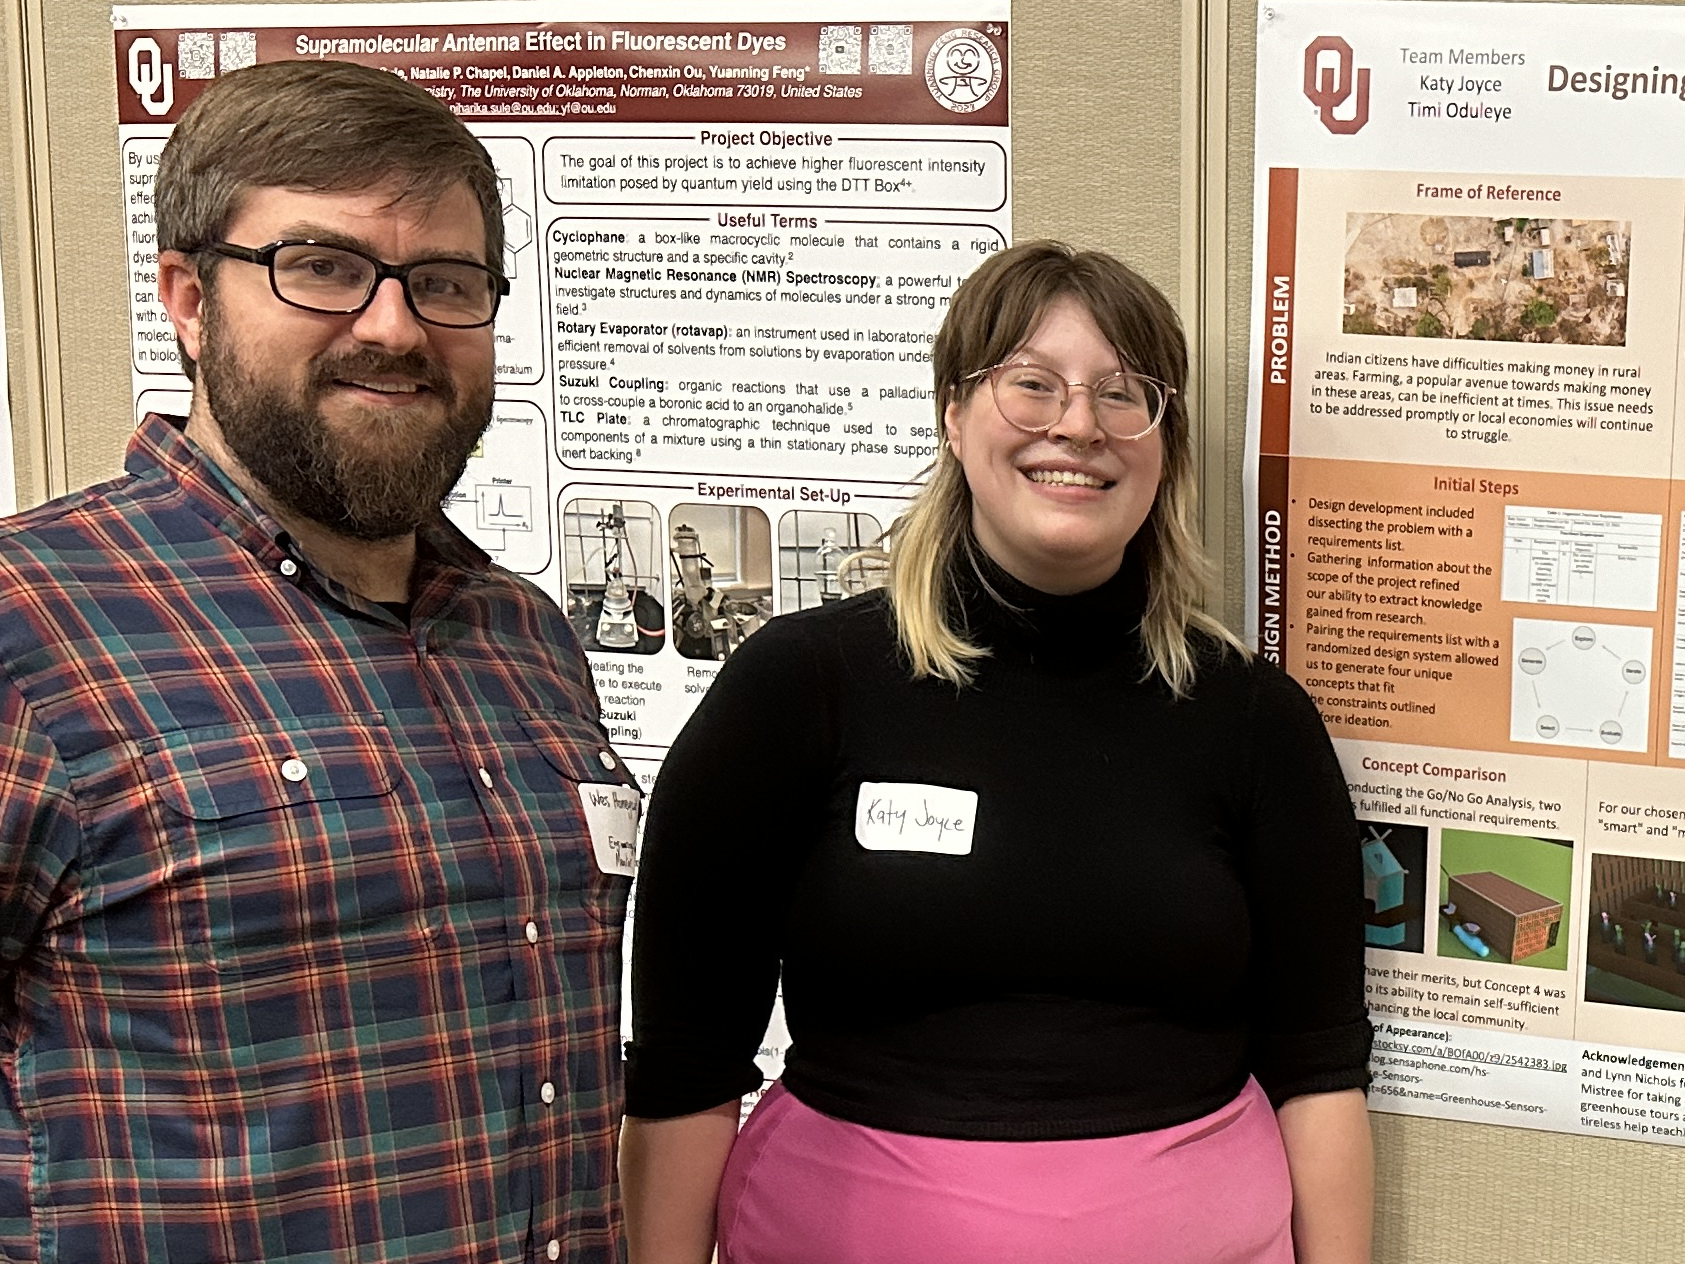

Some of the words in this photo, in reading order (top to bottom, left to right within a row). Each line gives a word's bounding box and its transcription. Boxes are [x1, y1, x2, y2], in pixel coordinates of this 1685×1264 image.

[295, 33, 439, 58] Supramolecular
[442, 33, 520, 52] Antenna
[525, 31, 582, 51] Effect
[587, 35, 605, 50] in
[611, 30, 732, 50] Fluorescent
[737, 32, 786, 55] Dyes
[1399, 47, 1442, 64] Team
[1448, 48, 1525, 65] Members
[128, 37, 174, 116] OU
[410, 66, 450, 79] Natalie
[452, 66, 463, 79] P.
[465, 65, 510, 82] Chapel,
[511, 65, 550, 78] Daniel
[552, 65, 566, 78] A.
[568, 65, 627, 81] Appleton,
[628, 65, 680, 78] Chenxin
[683, 64, 706, 80] Ou,
[708, 65, 769, 81] Yuanning
[460, 84, 481, 97] The
[484, 84, 539, 100] University
[541, 83, 554, 97] of
[555, 83, 616, 98] Oklahoma,
[619, 83, 669, 98] Norman,
[672, 83, 733, 97] Oklahoma
[736, 84, 776, 99] 73019,
[781, 84, 821, 97] United
[823, 84, 862, 98] States
[1303, 35, 1370, 135] OU
[1420, 75, 1454, 94] Katy
[1457, 75, 1501, 95] Joyce
[1407, 101, 1440, 117] Timi
[1446, 101, 1511, 122] Oduleye
[700, 130, 754, 149] Project
[759, 130, 832, 149] Objective
[1416, 183, 1463, 198] Frame
[1467, 184, 1483, 199] of
[1486, 184, 1561, 201] Reference
[717, 212, 765, 227] Useful
[770, 213, 817, 228] Terms
[554, 266, 600, 279] Nuclear
[605, 267, 661, 283] Magnetic
[666, 268, 736, 282] Resonance
[741, 269, 780, 286] (NMR)
[1270, 276, 1290, 384] PROBLEM
[559, 410, 584, 423] TLC
[697, 482, 794, 500] Experimental
[799, 486, 850, 506] Set-Up
[1434, 476, 1475, 492] Initial
[1479, 479, 1519, 497] Steps
[1265, 510, 1281, 607] METHOD
[1264, 613, 1280, 664] SIGN
[1361, 756, 1419, 776] Concept
[1422, 762, 1506, 782] Comparison
[867, 799, 907, 835] Katy
[914, 799, 965, 842] Joyce
